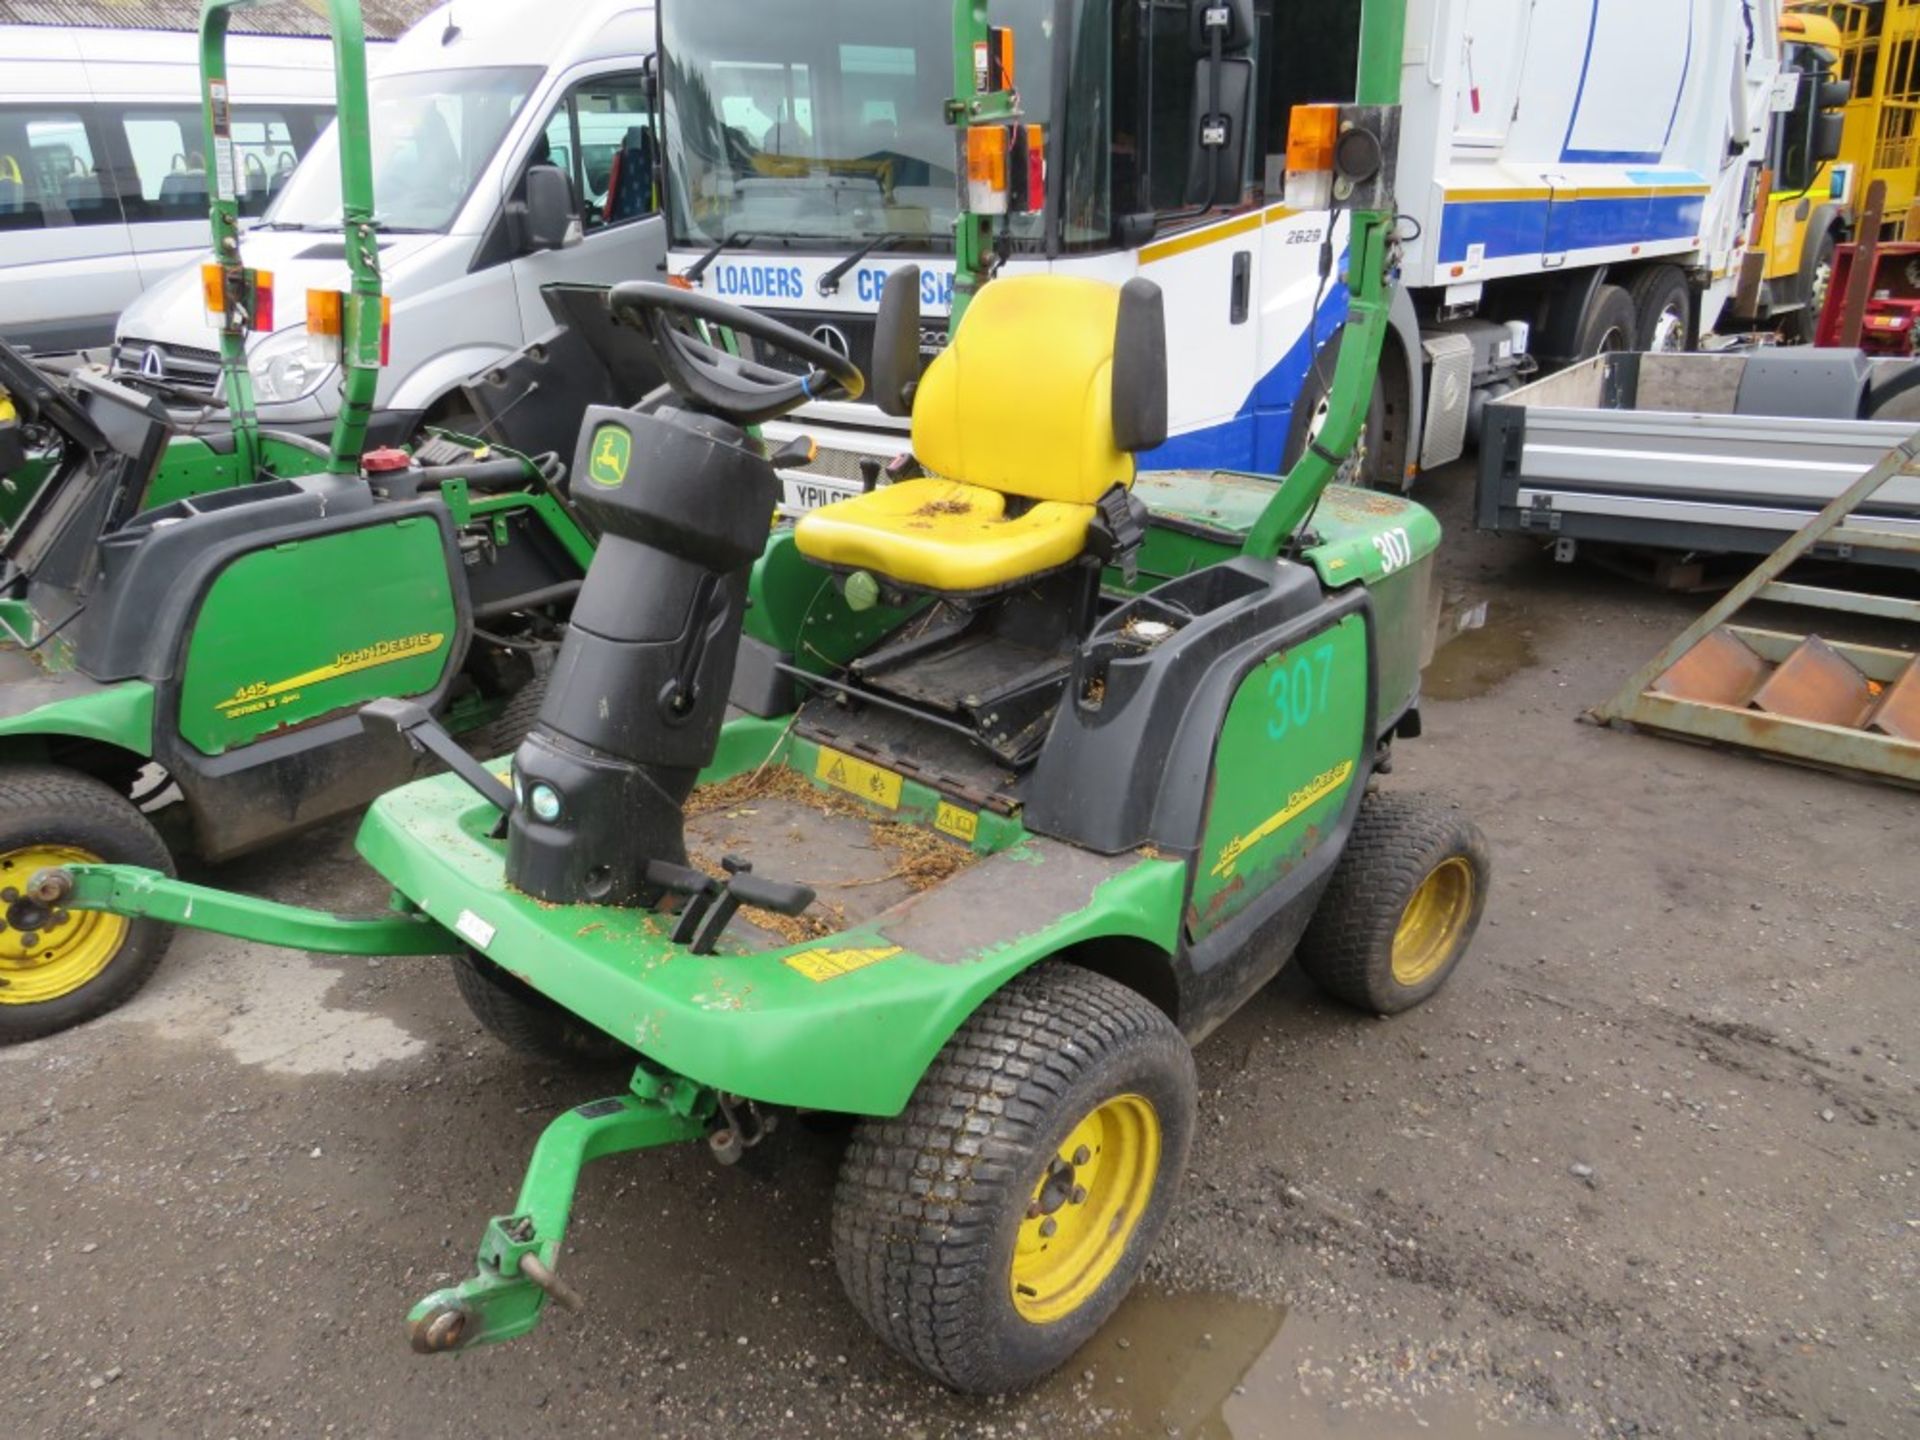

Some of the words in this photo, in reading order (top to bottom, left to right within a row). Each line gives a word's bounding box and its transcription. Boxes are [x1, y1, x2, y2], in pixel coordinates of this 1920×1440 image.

[716, 265, 803, 298] LOADERS
[1372, 527, 1410, 573] 307
[333, 648, 374, 668] JOHN
[374, 632, 431, 656] DEERE
[235, 681, 268, 700] 445
[1267, 644, 1333, 739] 307
